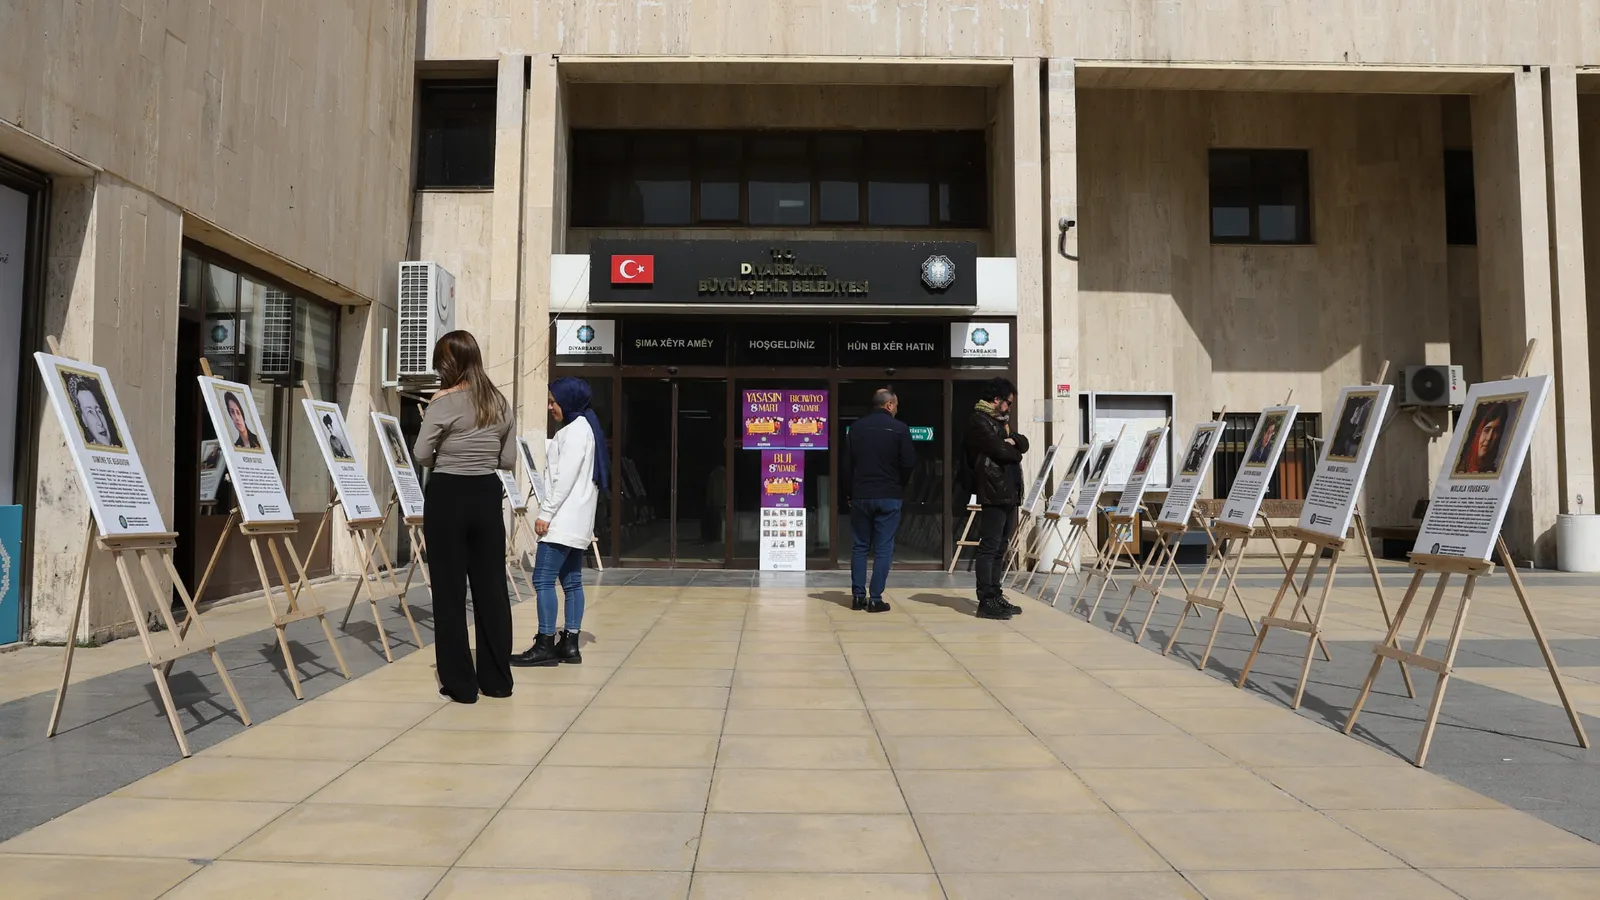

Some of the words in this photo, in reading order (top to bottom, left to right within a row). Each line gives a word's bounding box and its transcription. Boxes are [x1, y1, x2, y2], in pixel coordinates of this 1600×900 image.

[698, 277, 788, 295] BÜYÜKŞEHİR
[792, 279, 869, 293] BELEDİYESİ
[635, 339, 658, 349] ŞIMA
[660, 337, 685, 348] XÊYR
[686, 338, 714, 348] AMÊY
[749, 339, 815, 350] HOŞGELDİNİZ
[847, 340, 868, 351] HÛN
[870, 342, 881, 351] BI
[883, 340, 903, 351] XÊR
[905, 342, 935, 351] HATIN
[750, 403, 758, 413] 8
[758, 403, 779, 412] MART
[1450, 484, 1467, 493] MALALA
